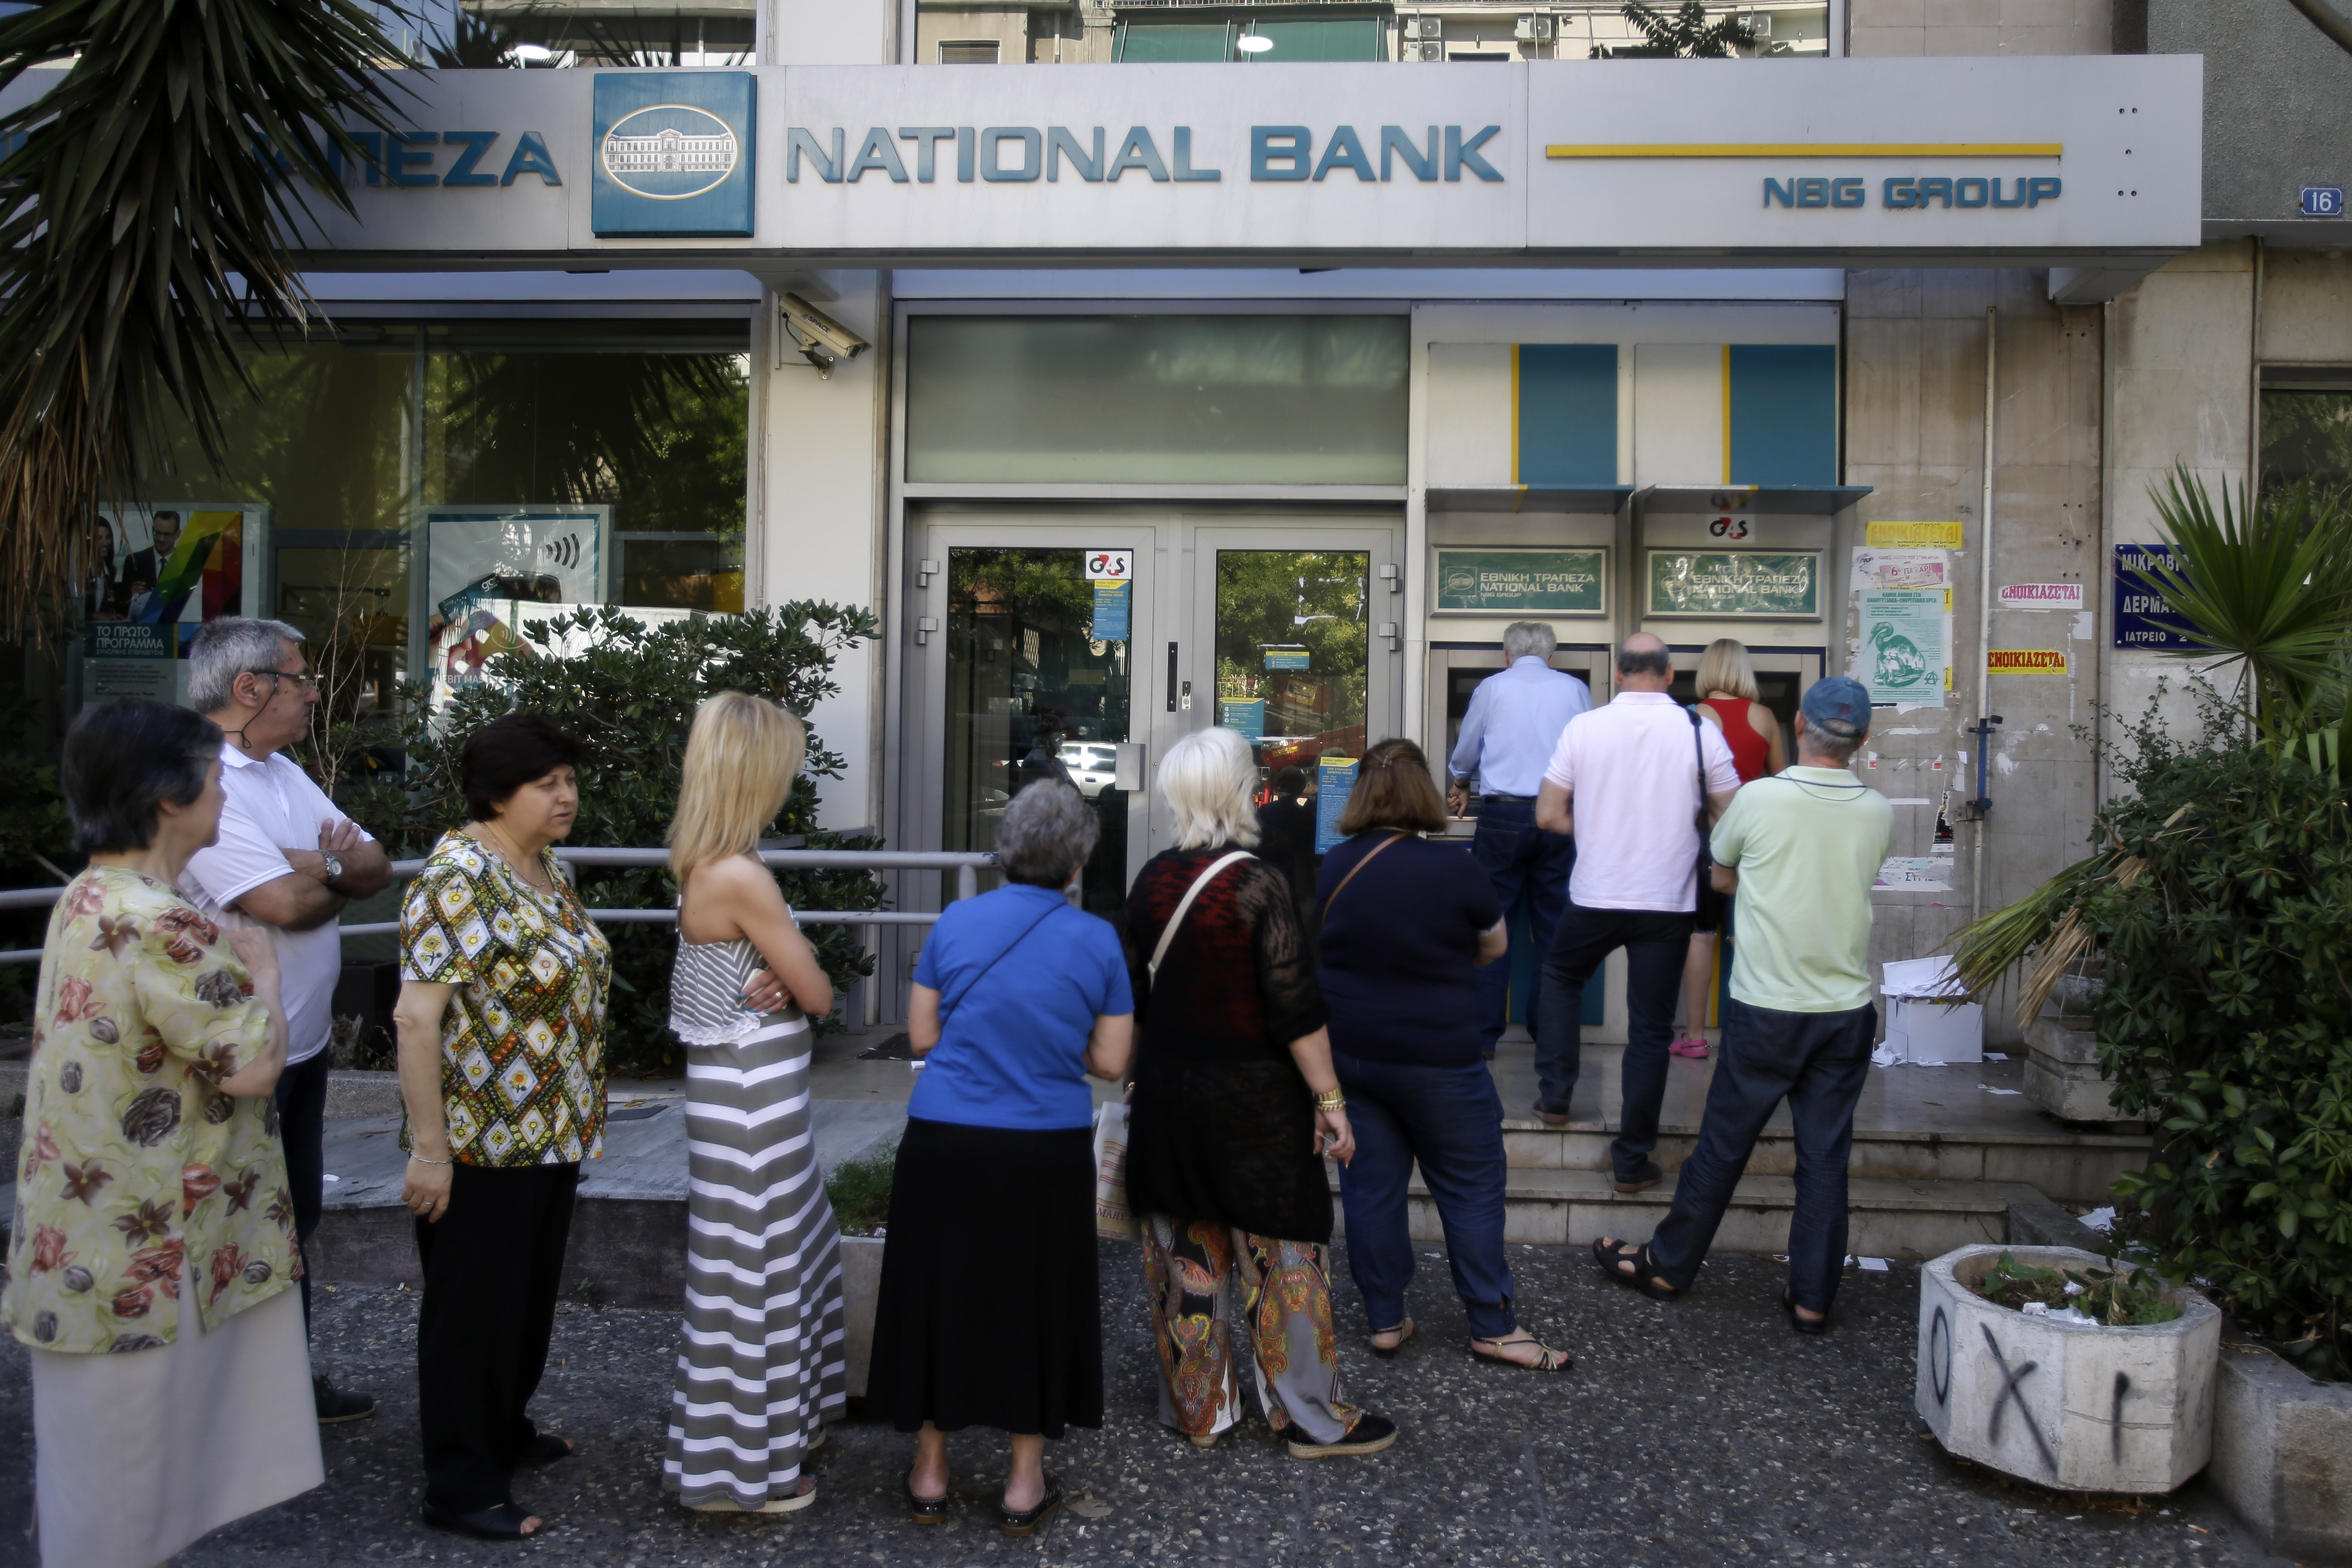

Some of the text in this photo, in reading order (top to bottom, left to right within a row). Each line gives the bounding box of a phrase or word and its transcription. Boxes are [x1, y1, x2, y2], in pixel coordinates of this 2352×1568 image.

[251, 131, 563, 186] ΑΠΕΖΑ
[786, 125, 1505, 182] NATIONAL BANK
[1763, 177, 2062, 208] NBG GROUP
[2312, 191, 2332, 211] 16
[808, 316, 831, 333] SPACE
[1709, 517, 1748, 540] G4S
[1089, 554, 1125, 576] G4S
[1480, 573, 1595, 583] ΕΘΝΙΚΗ ΤΡΑΠΕΖΑ
[1693, 574, 1809, 584] ΕΘΝΙΚΗ ΤΡΑΠΕΖΑ
[1480, 583, 1584, 593] NATIONAL BANK
[1693, 585, 1800, 594] NATIONAL BANK
[2001, 584, 2080, 600] ΕΝΟΙΚΙΑΖΕΤΑΙ
[2123, 596, 2176, 613] ΔΕΡΜΑ
[97, 626, 151, 637] ΤΟ ΠΡΩΤΟ
[2125, 632, 2166, 642] ΙΑΤΡΕΙΟ
[97, 637, 164, 649] ΠΡΟΓΡΑΜΜΑ
[1988, 652, 2064, 668] ΕΝΟΙΚΙΑΖΕΤΑΙ
